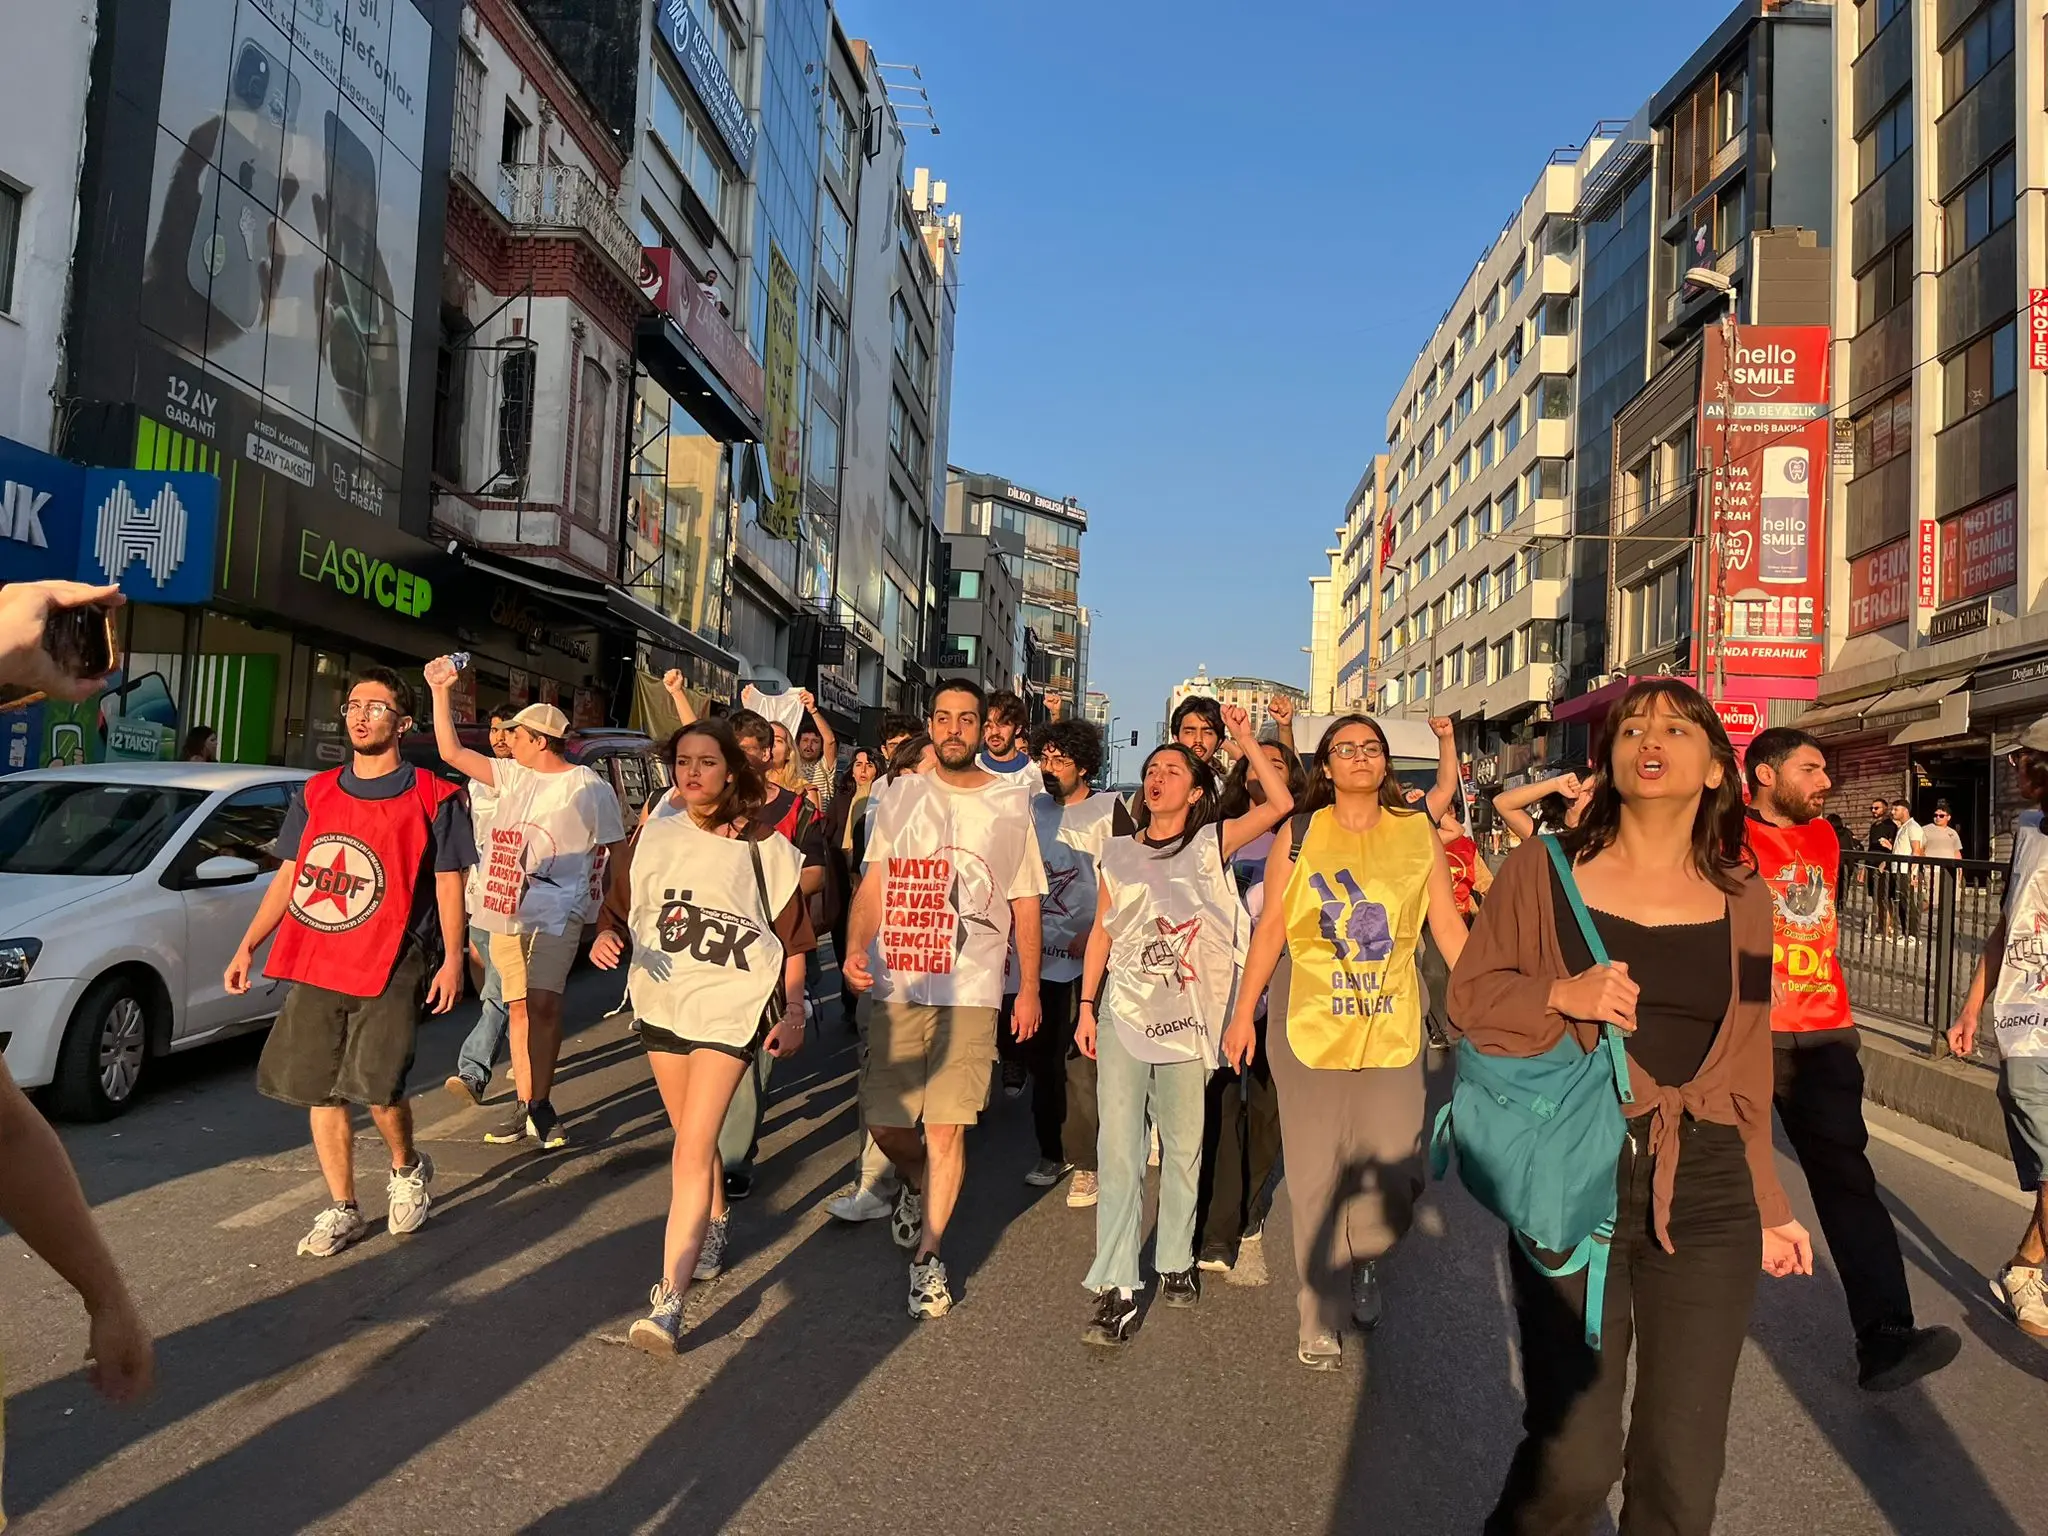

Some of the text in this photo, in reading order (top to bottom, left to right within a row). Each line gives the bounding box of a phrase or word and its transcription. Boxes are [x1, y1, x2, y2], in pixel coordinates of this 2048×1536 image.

[281, 12, 311, 51] tamir
[314, 48, 339, 82] ettir,
[341, 75, 384, 123] sigortala
[333, 10, 414, 116] telefonlar.
[2033, 305, 2048, 367] NOTER
[1733, 368, 1795, 385] SMILE
[167, 376, 218, 419] 12 AY
[1759, 405, 1817, 416] BEYAZLIK
[165, 404, 216, 439] GARANTİ
[1715, 422, 1805, 434] AIZ ve DİŞ BAKIMI
[254, 420, 309, 456] KREDİ KARTINA
[280, 456, 313, 483] TAKSİT
[1715, 466, 1749, 476] DHA
[351, 473, 383, 499] TAKAS
[1715, 482, 1752, 491] BYAZ
[350, 491, 382, 517] FIRSATI
[1007, 486, 1031, 503] DİLKO
[1034, 495, 1065, 514] ENGLISH
[1714, 497, 1748, 506] DHA
[1714, 511, 1751, 521] FRAH
[1763, 517, 1806, 531] hello
[1964, 499, 2013, 537] NOTER
[1726, 538, 1742, 548] 4D
[1727, 548, 1745, 556] ARE
[1762, 533, 1806, 545] SMILE
[1965, 525, 2013, 563] YEMİNLİ
[300, 528, 432, 618] EASYCEP
[1868, 543, 1909, 587] CENK
[1962, 552, 2015, 588] TERCÜME
[940, 551, 951, 641] ECZANE
[940, 651, 967, 665] OPTİK
[1751, 648, 1808, 659] FERAHLIK
[110, 732, 122, 748] 12
[298, 863, 374, 899] SGDF
[888, 857, 950, 881] NATO
[885, 890, 945, 910] SAVAŞ
[656, 888, 761, 972] ÖGK
[885, 910, 955, 930] KARŞITI
[883, 928, 953, 951] GENÇLİK
[885, 948, 952, 974] BİRLİĞİ
